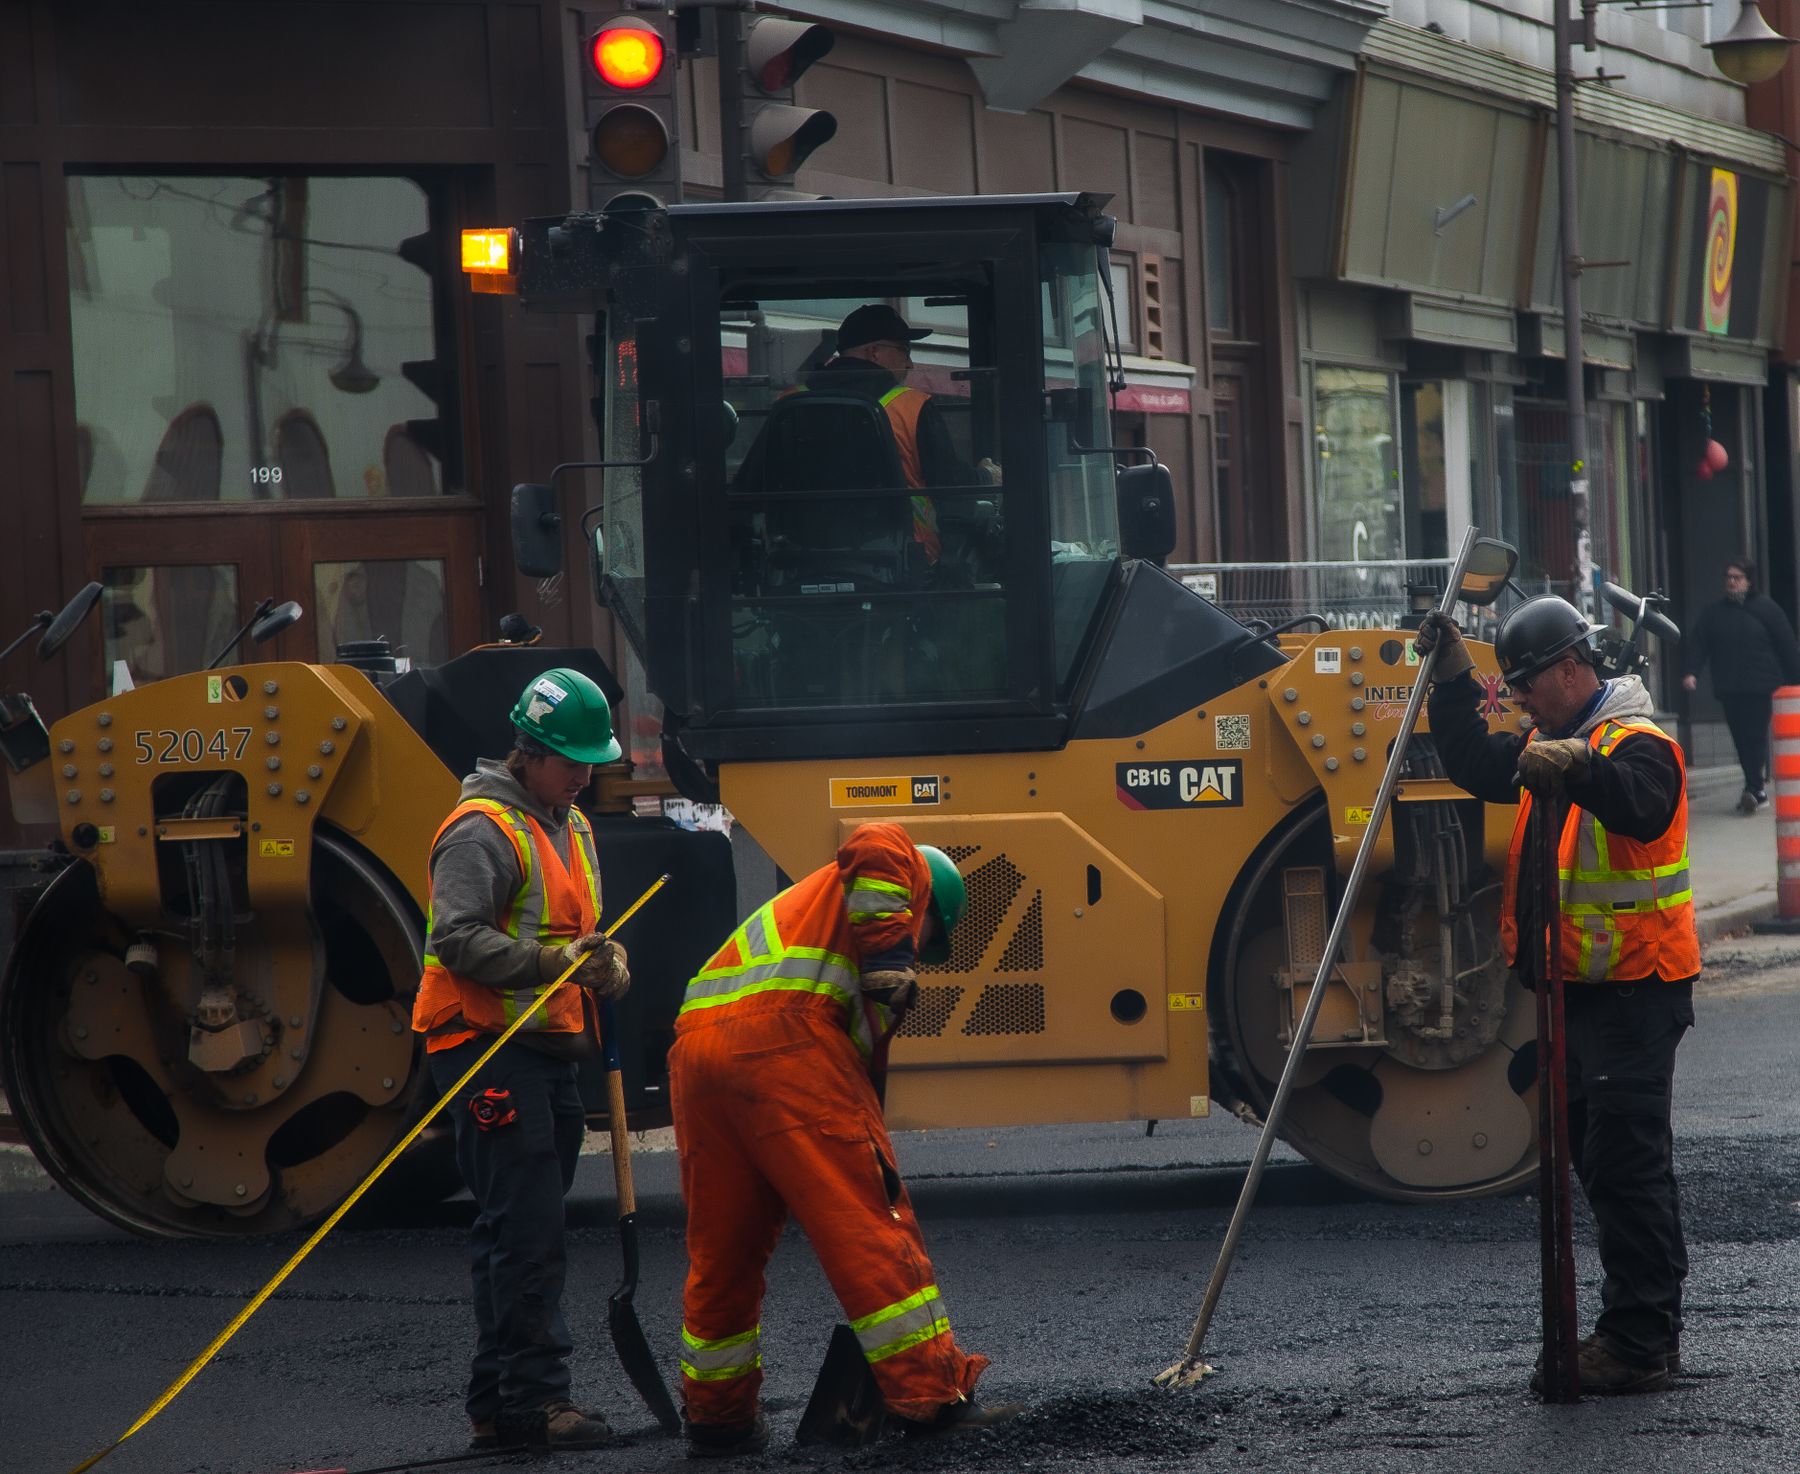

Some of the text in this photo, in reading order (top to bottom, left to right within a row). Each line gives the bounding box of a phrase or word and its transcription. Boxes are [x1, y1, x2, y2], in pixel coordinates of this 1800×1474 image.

[250, 466, 283, 484] 199
[135, 727, 253, 765] 52047
[846, 783, 937, 798] TOROMONT CAT
[1126, 766, 1236, 802] CB16 CAT
